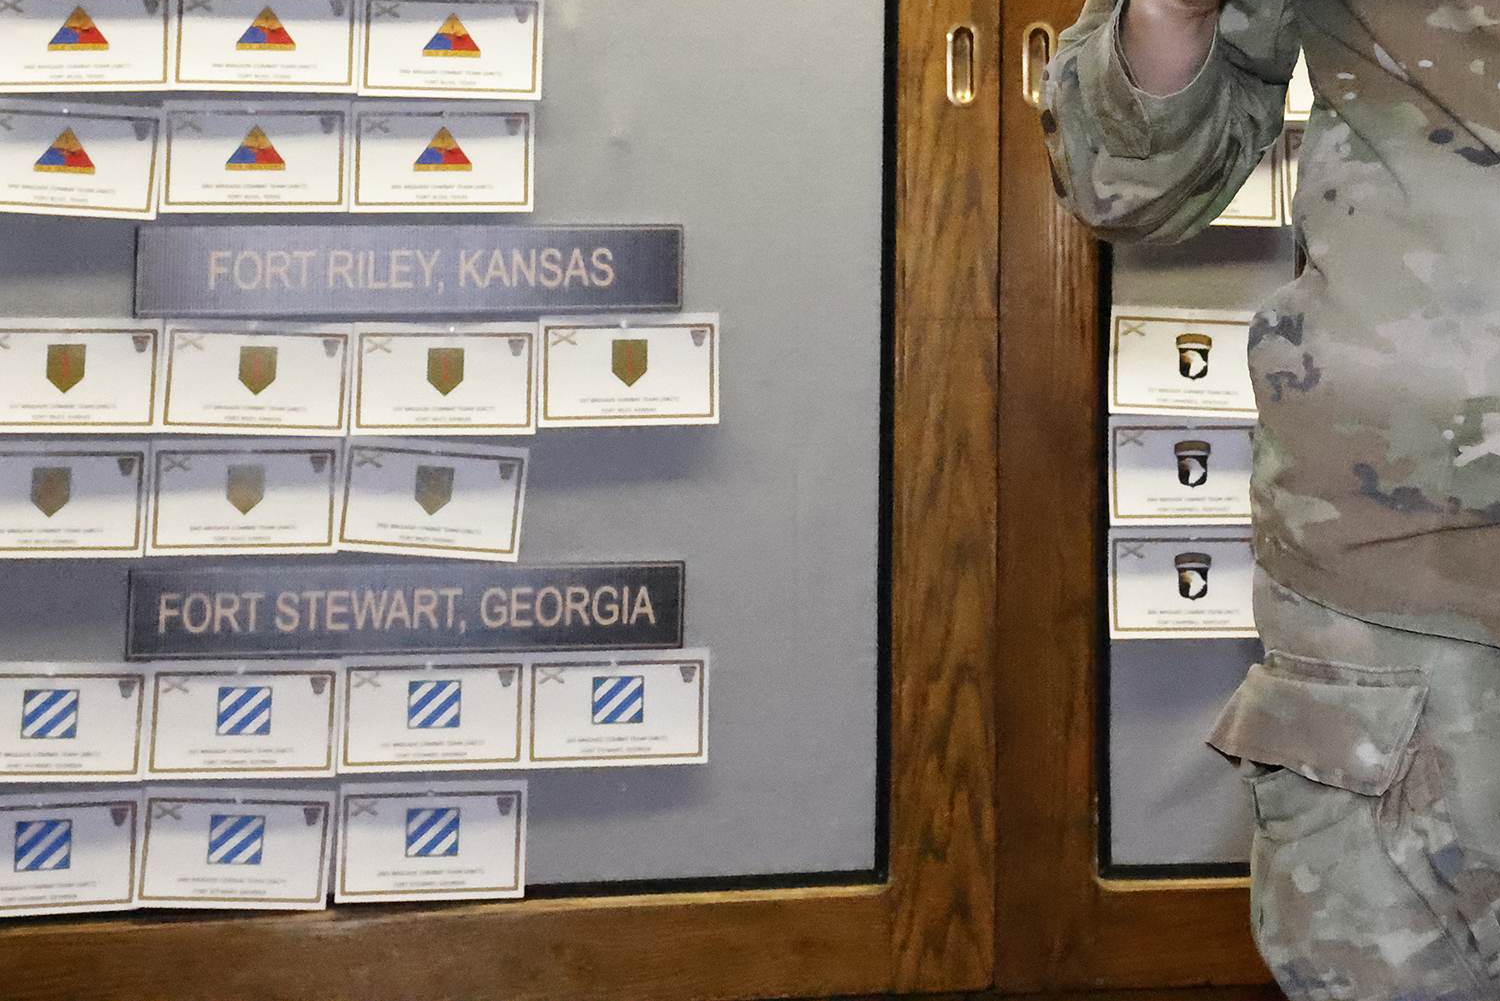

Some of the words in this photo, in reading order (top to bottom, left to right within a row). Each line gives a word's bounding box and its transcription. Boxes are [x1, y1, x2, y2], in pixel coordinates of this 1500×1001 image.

[209, 250, 319, 290] FORT
[326, 249, 444, 294] RILEY,
[458, 247, 615, 288] KANSAS
[158, 592, 265, 634] FORT
[275, 586, 468, 634] STEWART,
[479, 584, 656, 629] GEORGIA
